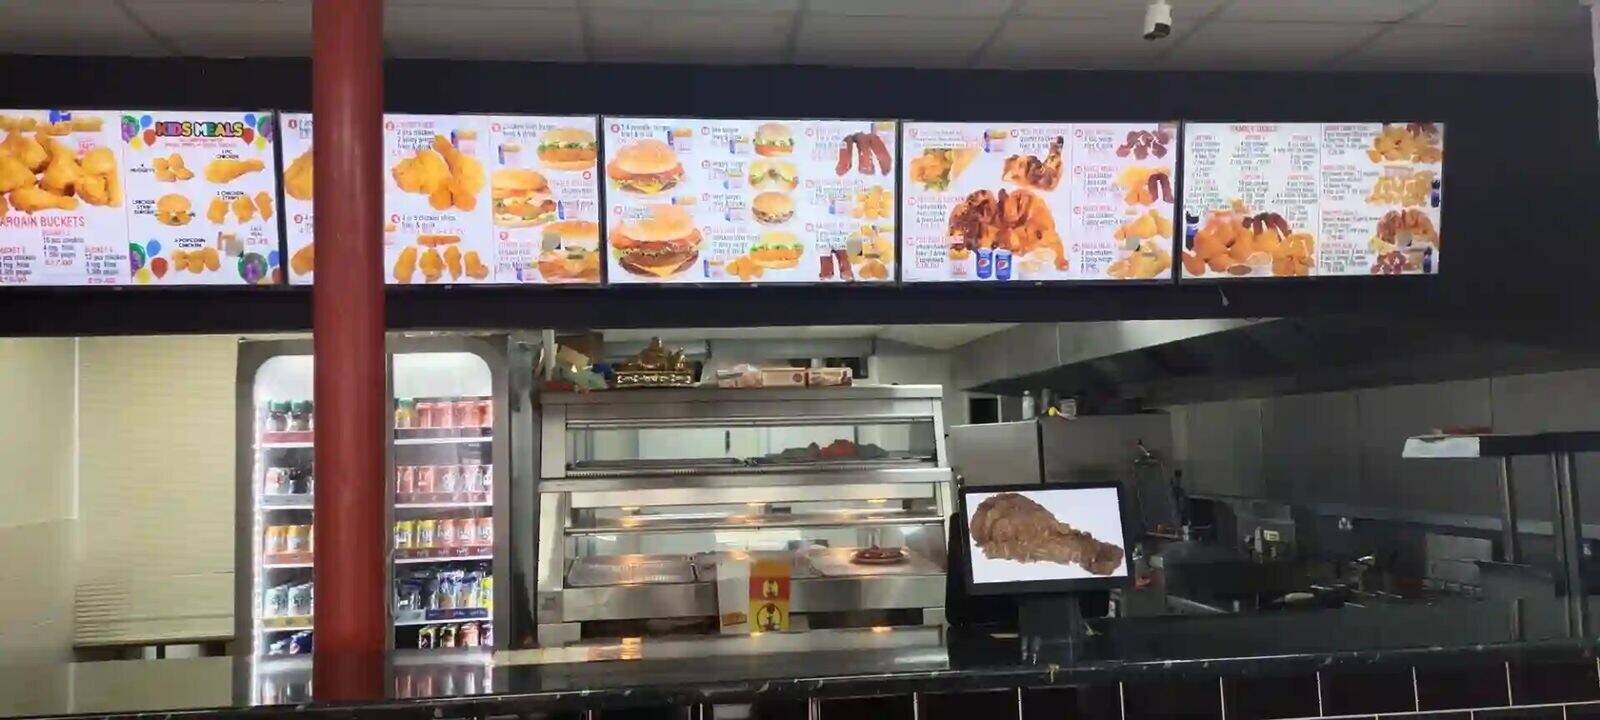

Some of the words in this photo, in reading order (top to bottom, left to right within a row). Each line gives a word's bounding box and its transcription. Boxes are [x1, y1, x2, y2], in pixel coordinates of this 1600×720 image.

[155, 121, 192, 137] KIDS
[194, 121, 244, 137] MEALS
[40, 216, 85, 228] BUCKETS
